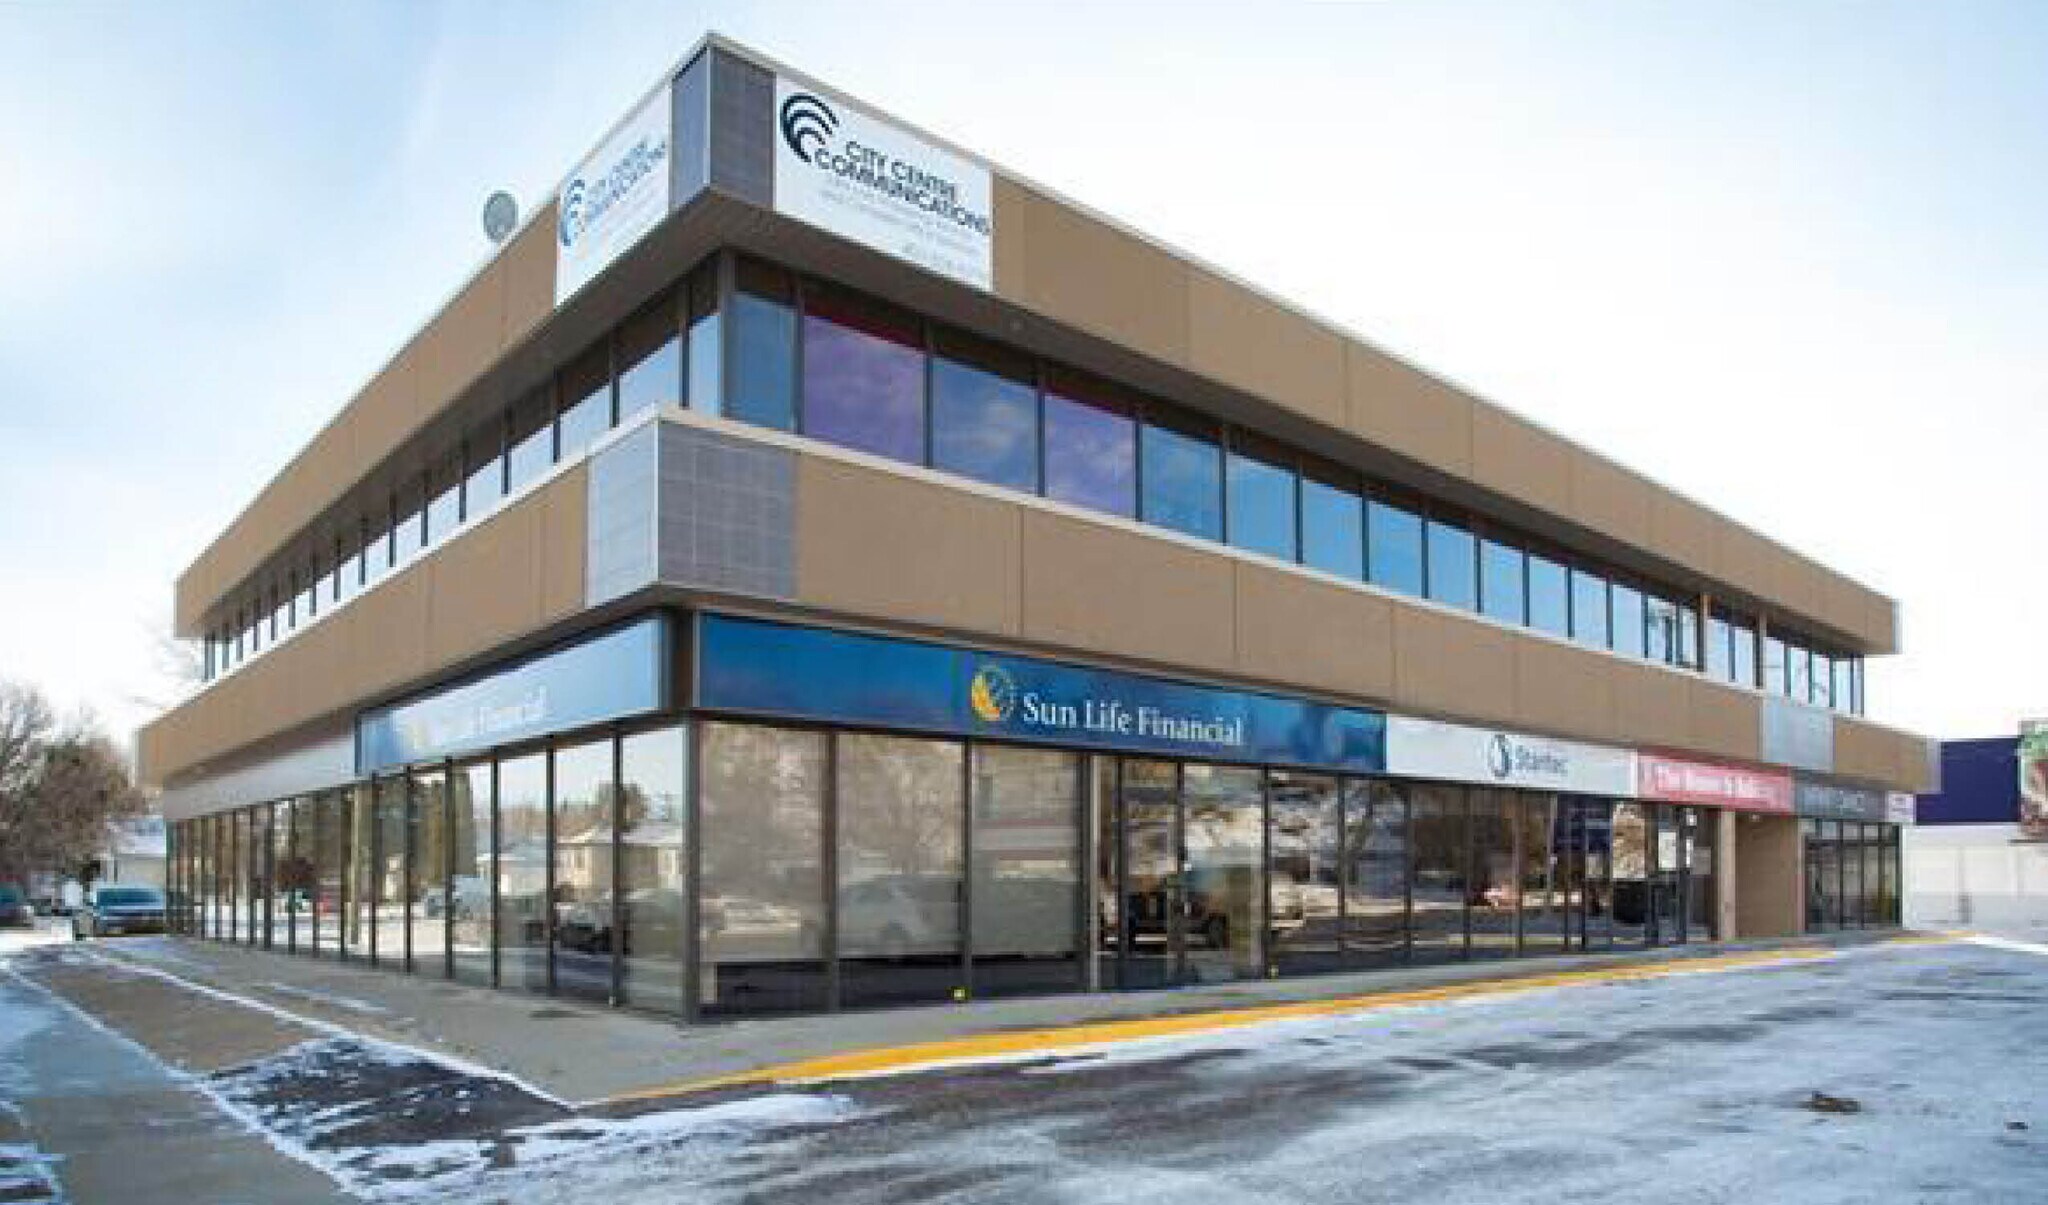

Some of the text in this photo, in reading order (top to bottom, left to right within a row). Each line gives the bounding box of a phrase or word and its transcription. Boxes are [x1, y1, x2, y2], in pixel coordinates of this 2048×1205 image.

[815, 148, 990, 236] COMMUNICATIONS
[845, 141, 956, 202] CITY CENTRE
[1022, 692, 1243, 746] Sun Life Financial
